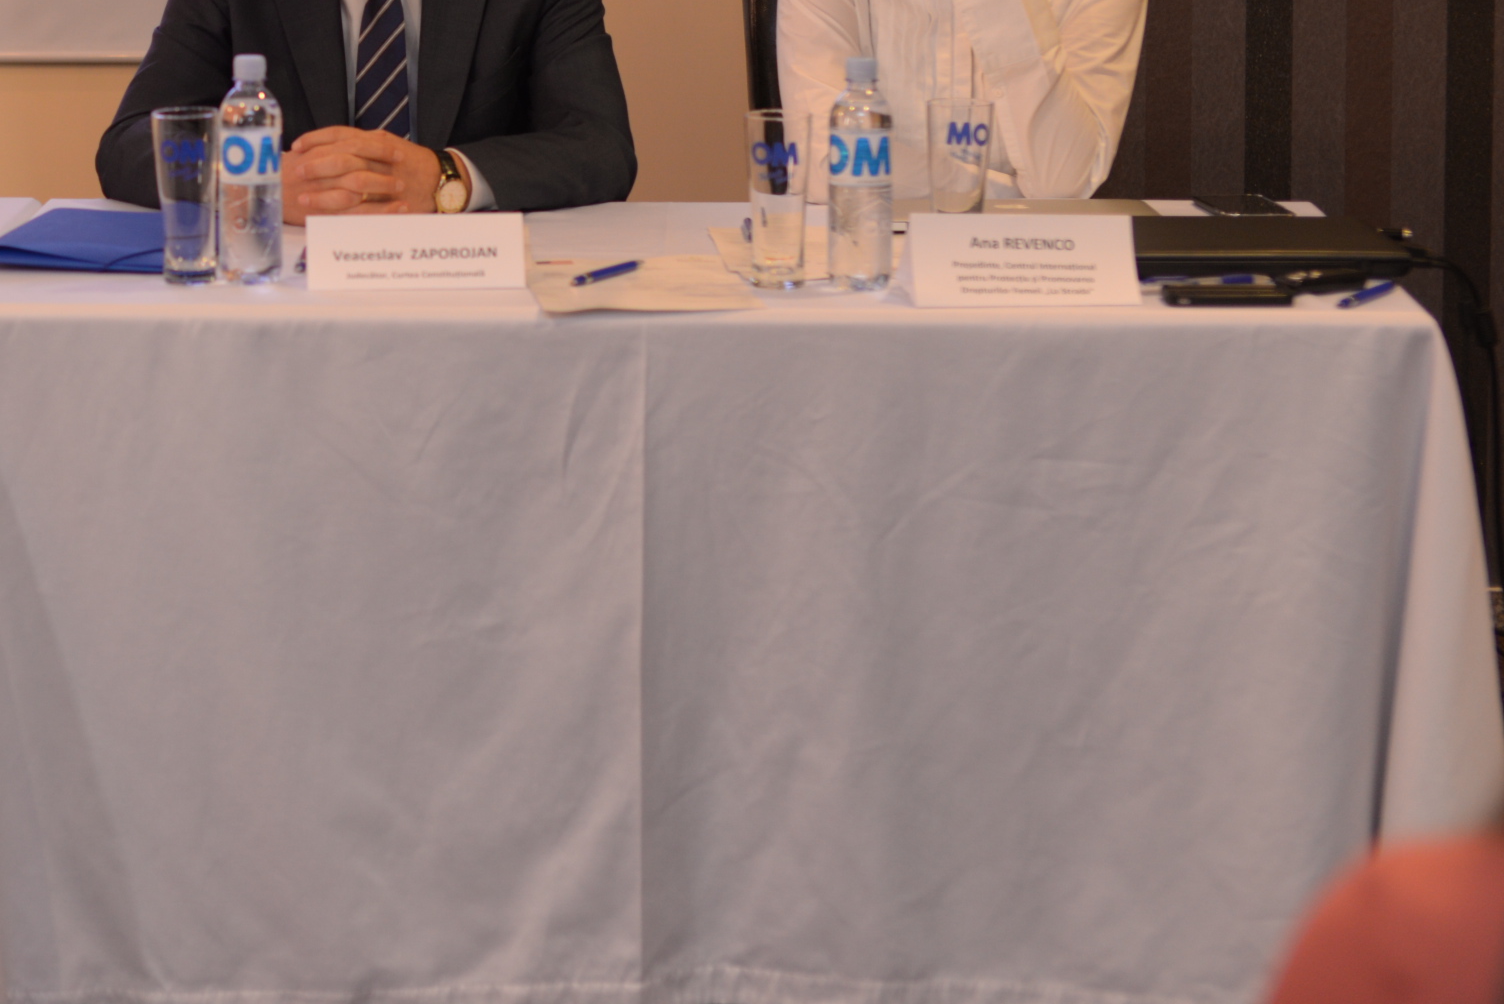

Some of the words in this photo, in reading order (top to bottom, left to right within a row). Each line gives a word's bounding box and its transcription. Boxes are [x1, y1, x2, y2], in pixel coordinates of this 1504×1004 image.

[752, 141, 798, 166] OM
[830, 134, 891, 176] OM
[333, 249, 403, 261] Veaceslav
[410, 246, 498, 260] ZAPOROJAN
[969, 237, 999, 249] Ana
[1003, 237, 1075, 251] REVENCO
